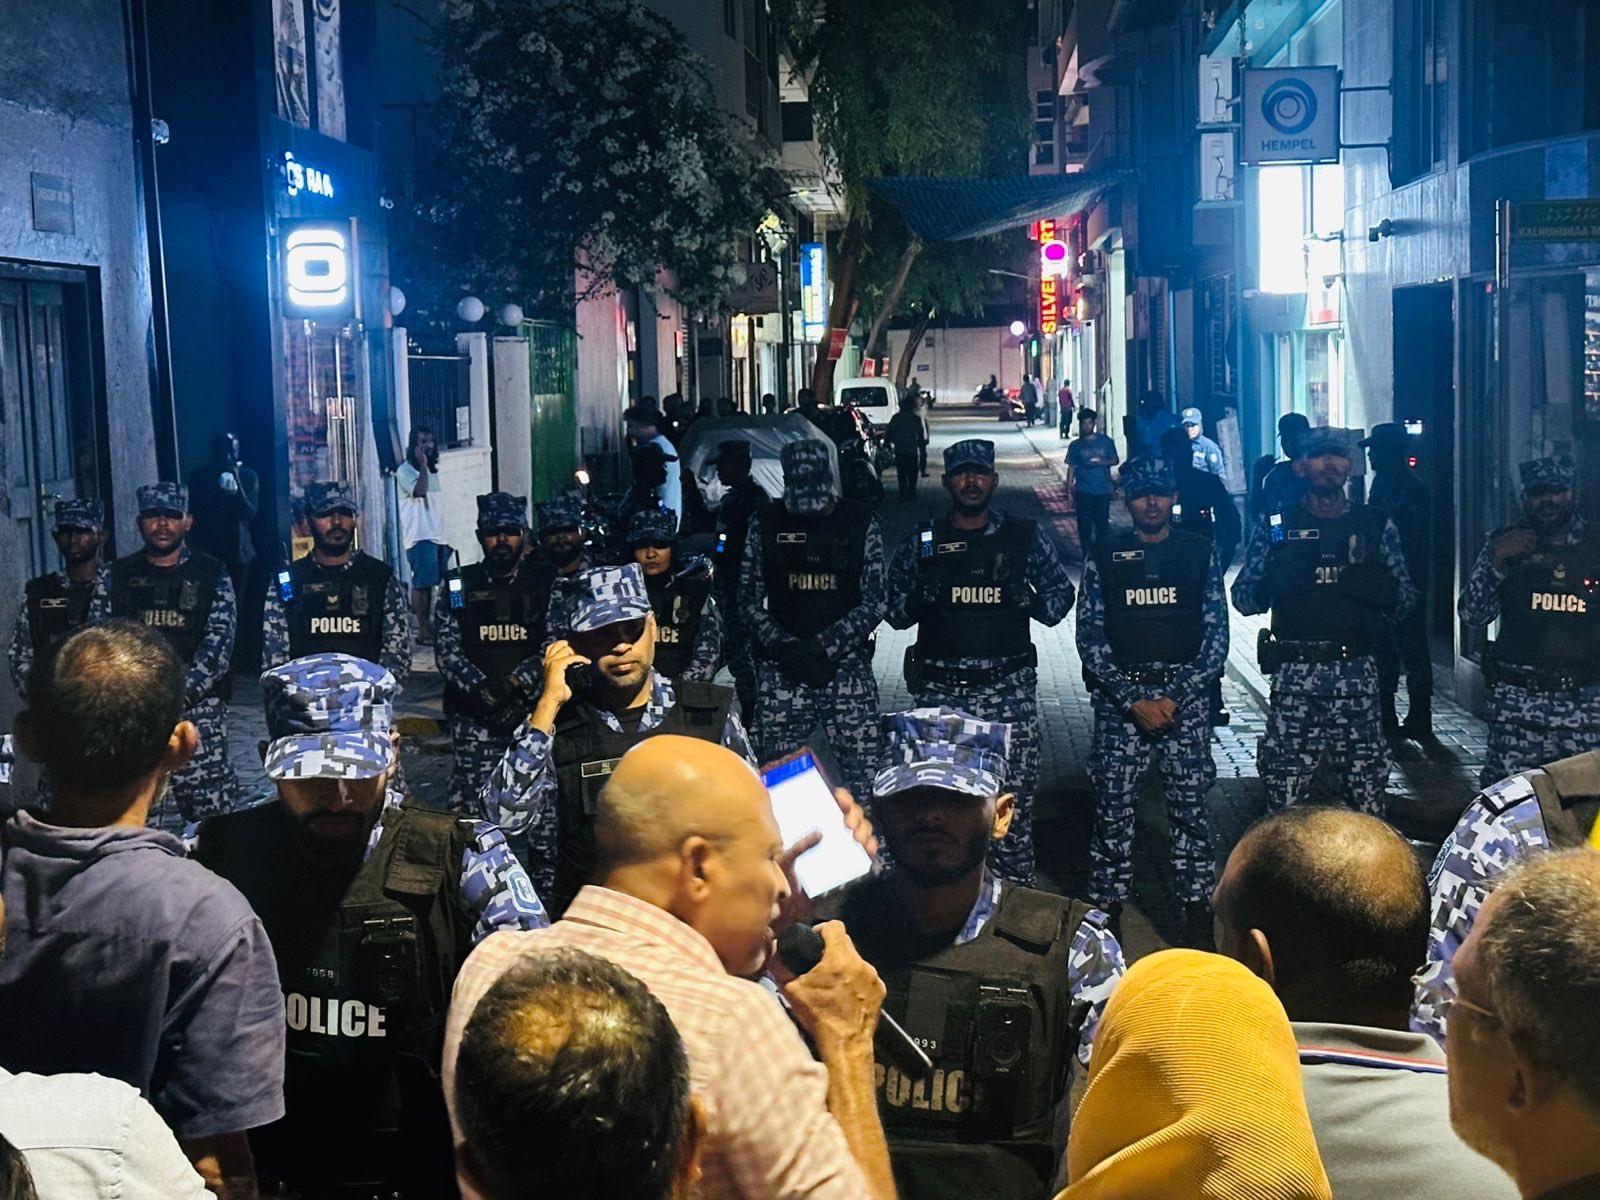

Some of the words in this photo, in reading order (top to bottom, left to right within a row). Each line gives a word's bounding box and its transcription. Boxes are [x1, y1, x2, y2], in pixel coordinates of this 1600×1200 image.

[1261, 139, 1317, 151] HEMPEL
[1041, 268, 1057, 335] SILVE
[788, 573, 838, 590] POLICE
[951, 586, 1002, 604] POLICE
[1125, 586, 1178, 606] POLICE
[1531, 592, 1587, 613] POLICE
[144, 609, 185, 627] OLICE
[311, 616, 361, 634] POLICE
[479, 624, 528, 641] POLICE
[286, 992, 387, 1038] OLICE
